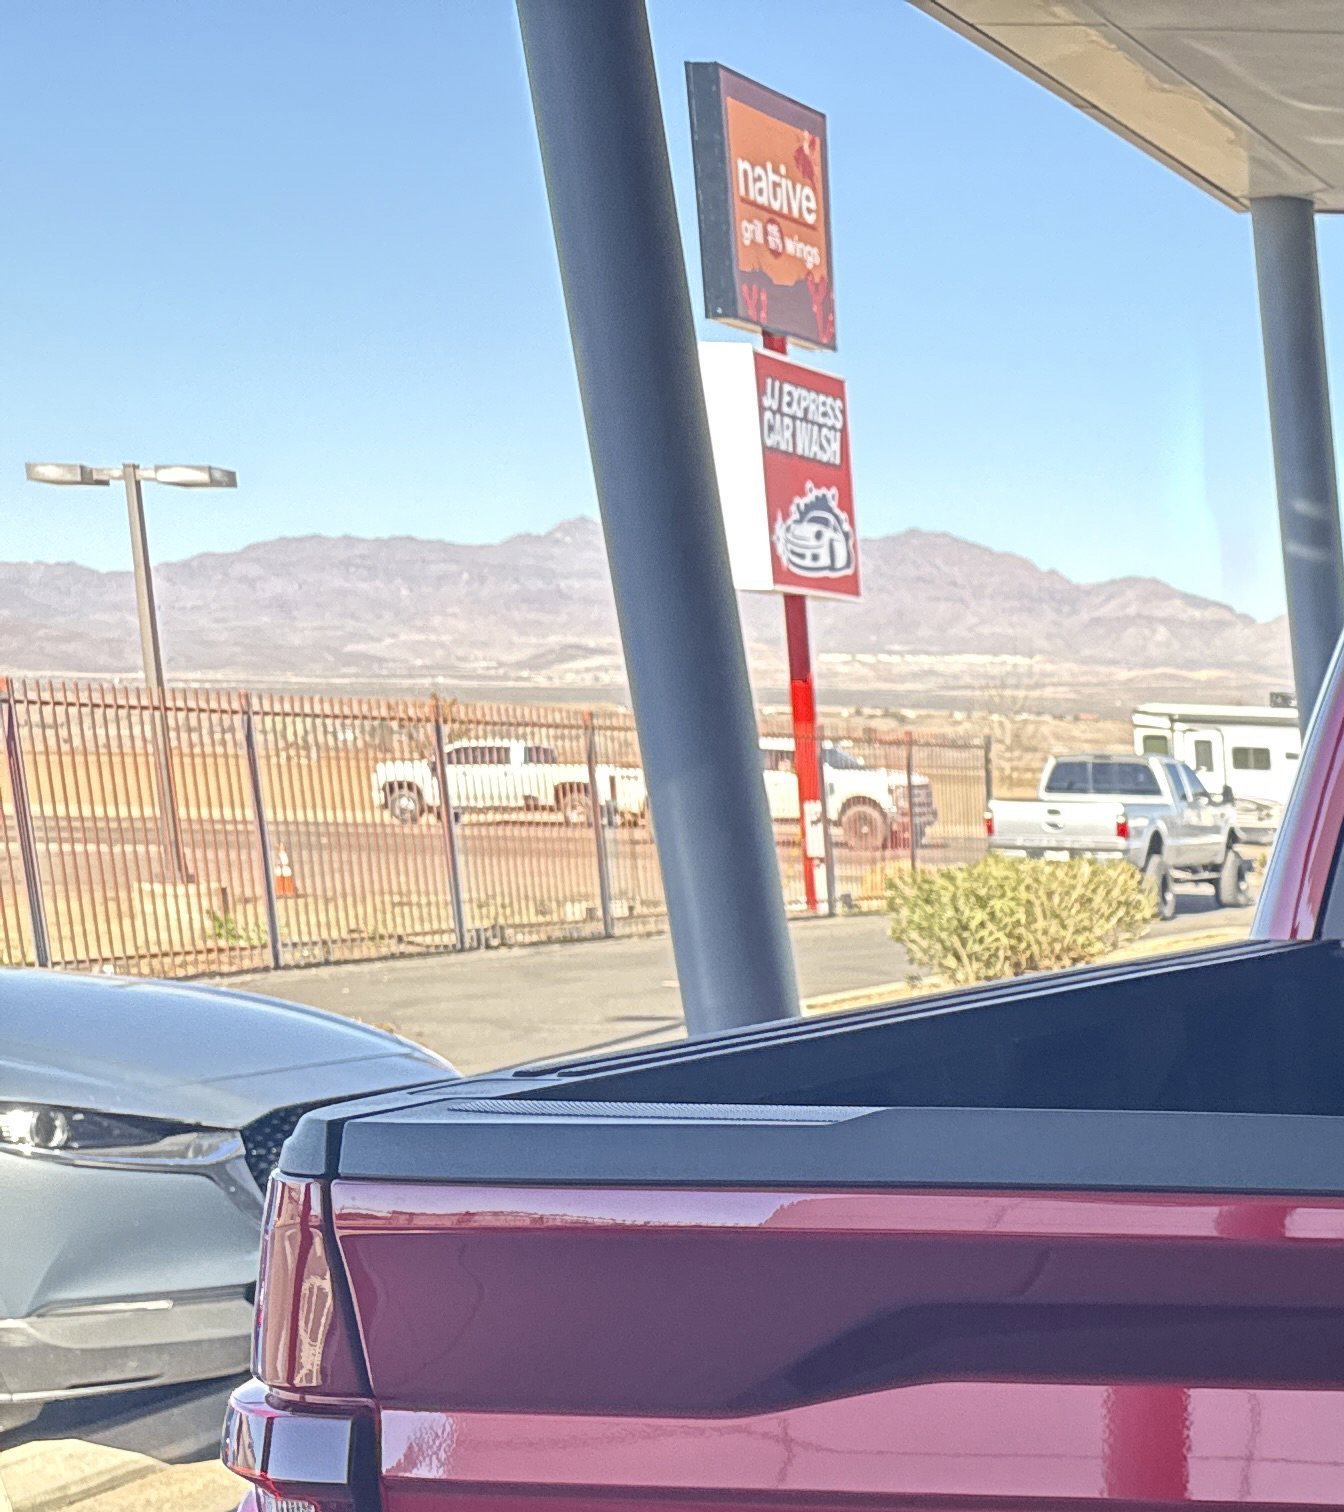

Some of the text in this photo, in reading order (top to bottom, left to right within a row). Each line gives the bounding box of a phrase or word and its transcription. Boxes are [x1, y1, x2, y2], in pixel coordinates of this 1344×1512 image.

[737, 157, 817, 225] native
[783, 235, 821, 270] wings
[762, 377, 843, 429] JJ EXPRESS
[763, 410, 841, 465] CAR WASH
